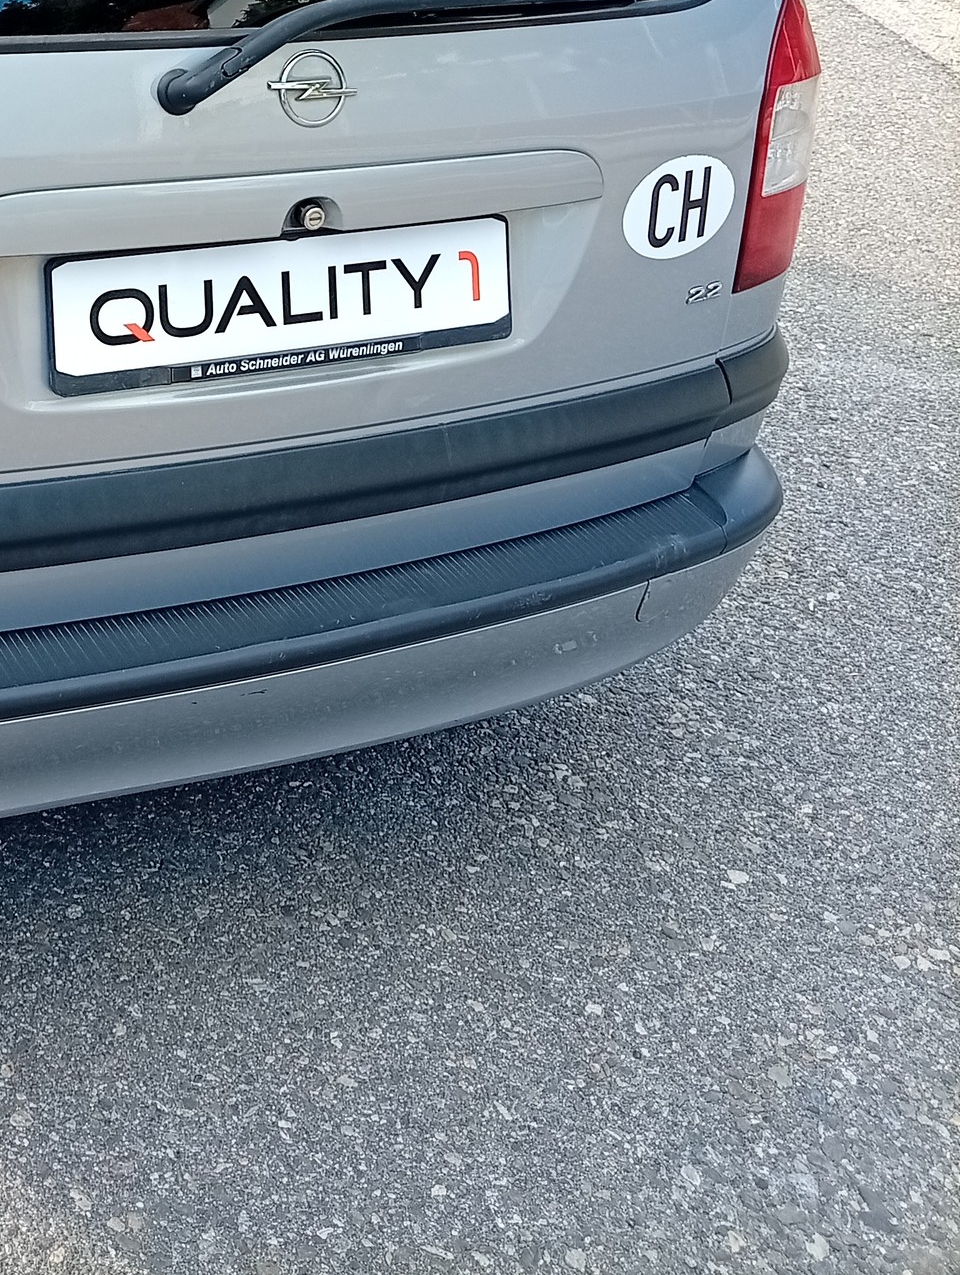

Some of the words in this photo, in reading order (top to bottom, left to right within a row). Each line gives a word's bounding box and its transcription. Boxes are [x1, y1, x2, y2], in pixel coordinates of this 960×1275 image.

[647, 165, 712, 248] CH
[89, 253, 441, 346] QUALITY
[458, 250, 481, 302] 1
[206, 362, 237, 376] Auto
[240, 354, 304, 372] Schneider
[306, 350, 325, 363] AG
[328, 340, 404, 360] Würenlingen
